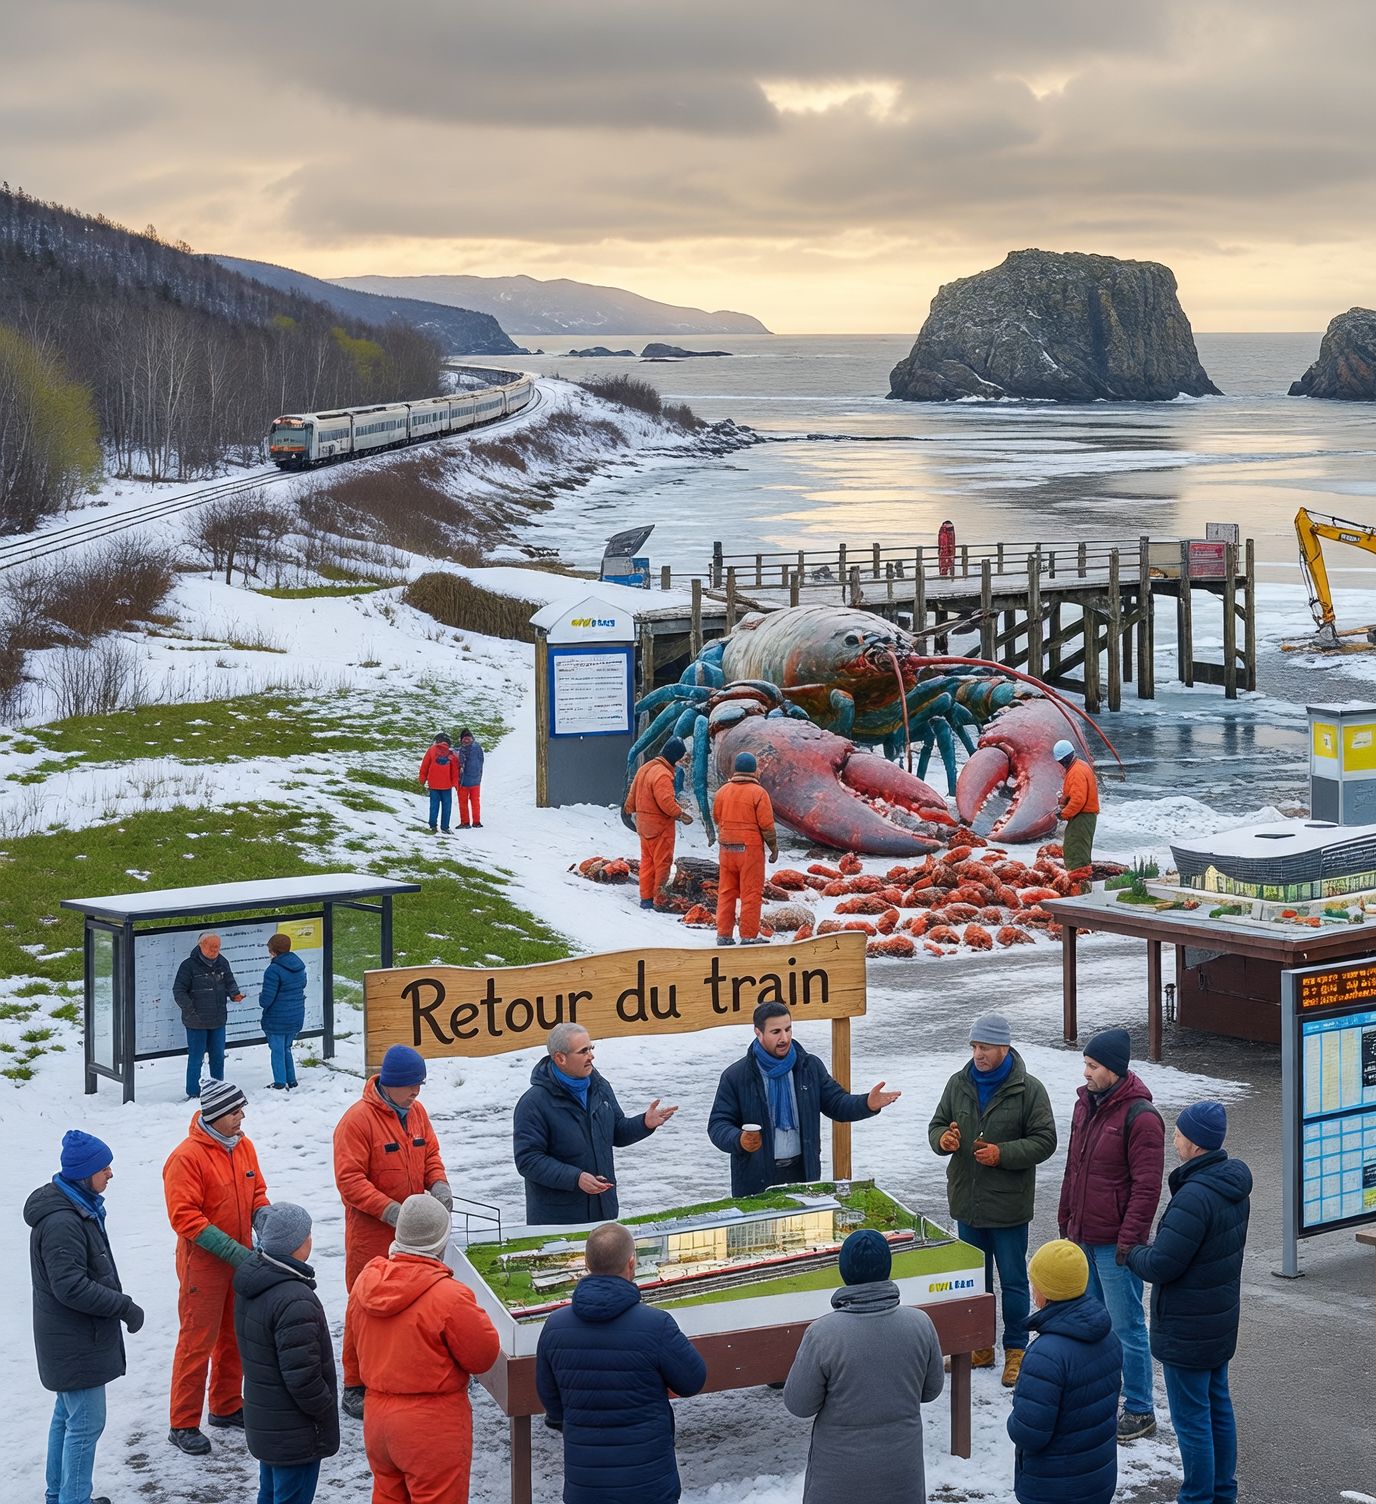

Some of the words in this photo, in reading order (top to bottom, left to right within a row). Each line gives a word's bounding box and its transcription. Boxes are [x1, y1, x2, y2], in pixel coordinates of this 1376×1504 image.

[401, 977, 593, 1047] Retour
[616, 959, 682, 1023] du
[703, 955, 829, 1014] train
